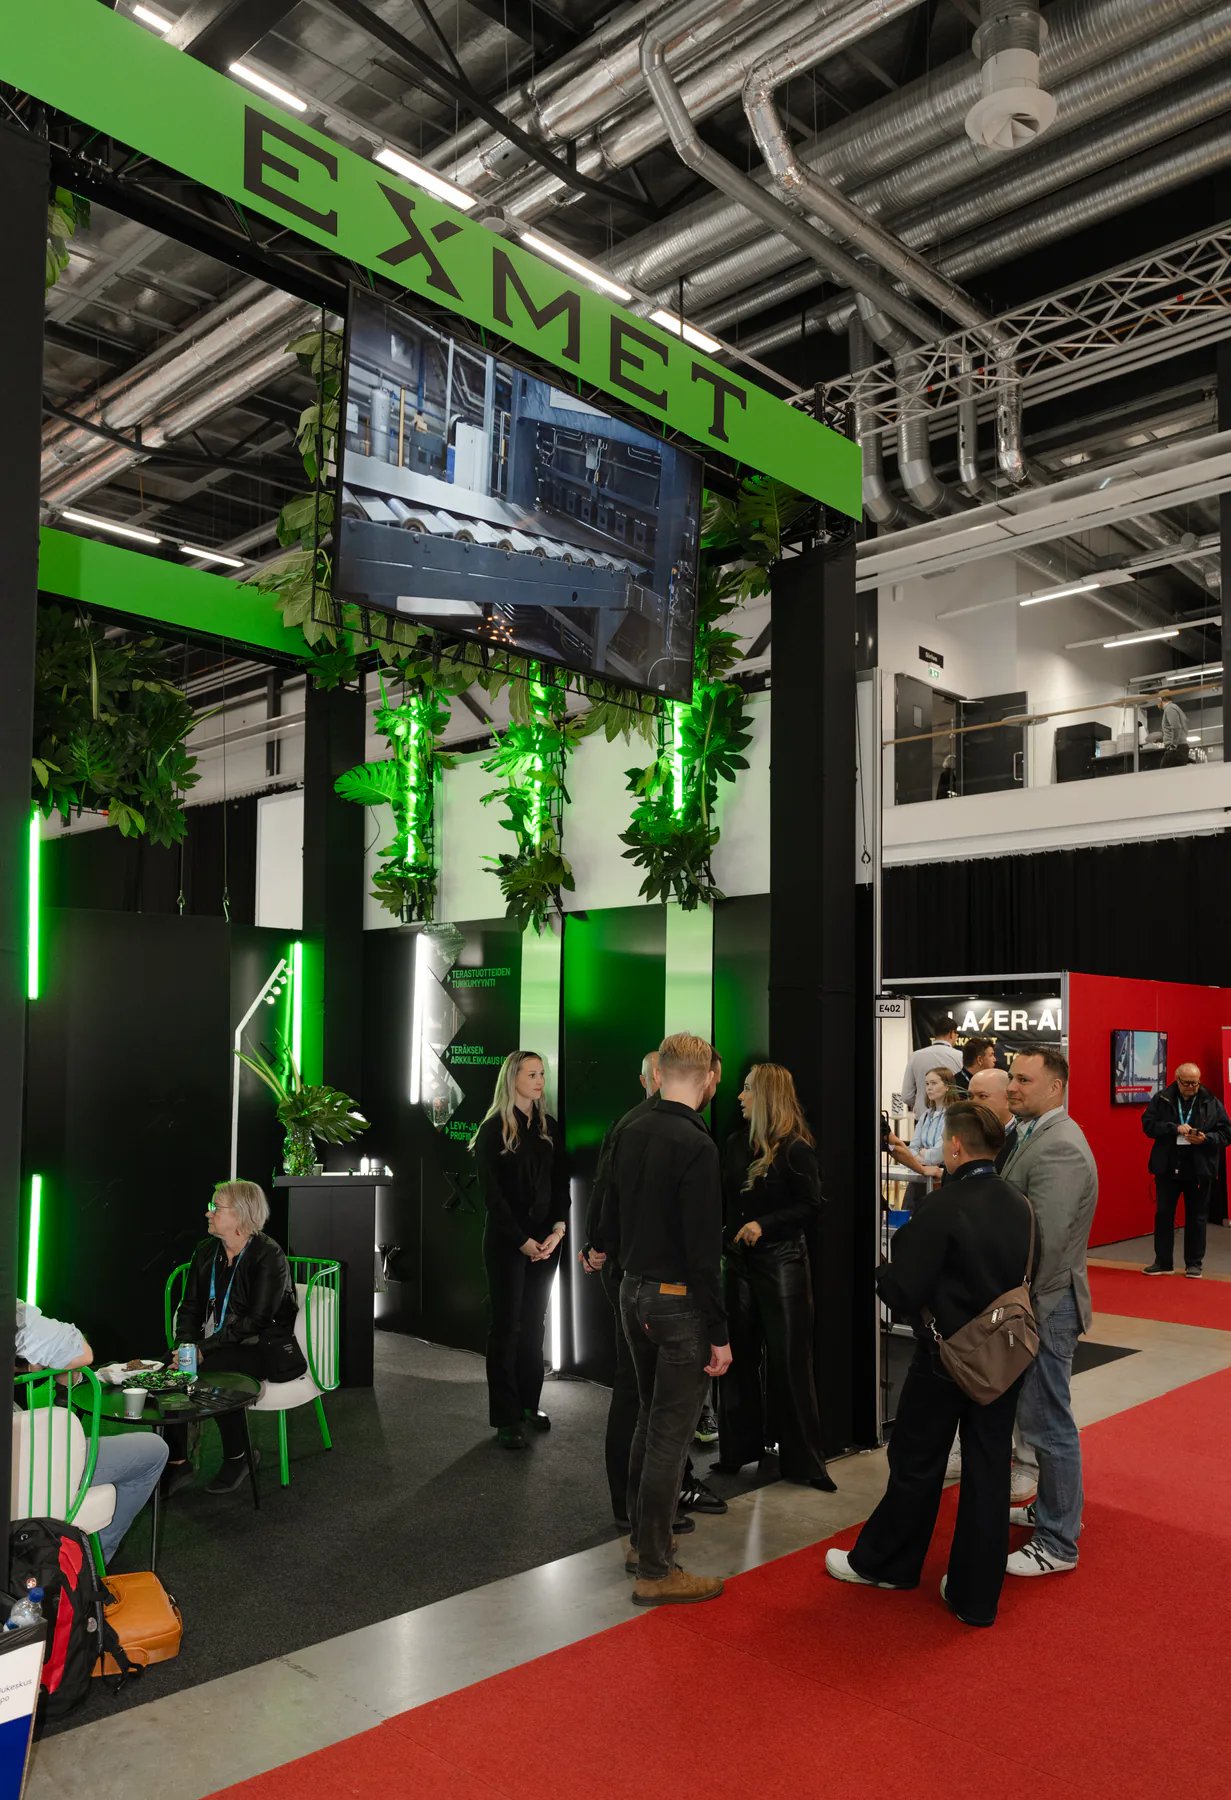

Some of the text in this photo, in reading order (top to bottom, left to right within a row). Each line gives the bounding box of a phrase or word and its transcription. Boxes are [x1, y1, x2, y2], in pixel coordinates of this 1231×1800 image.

[244, 105, 747, 443] EXMET
[879, 1004, 901, 1013] E402
[450, 1044, 484, 1055] TERÄKSEN
[450, 1056, 500, 1065] ARKKILEIKKAUS
[468, 1122, 478, 1131] JA
